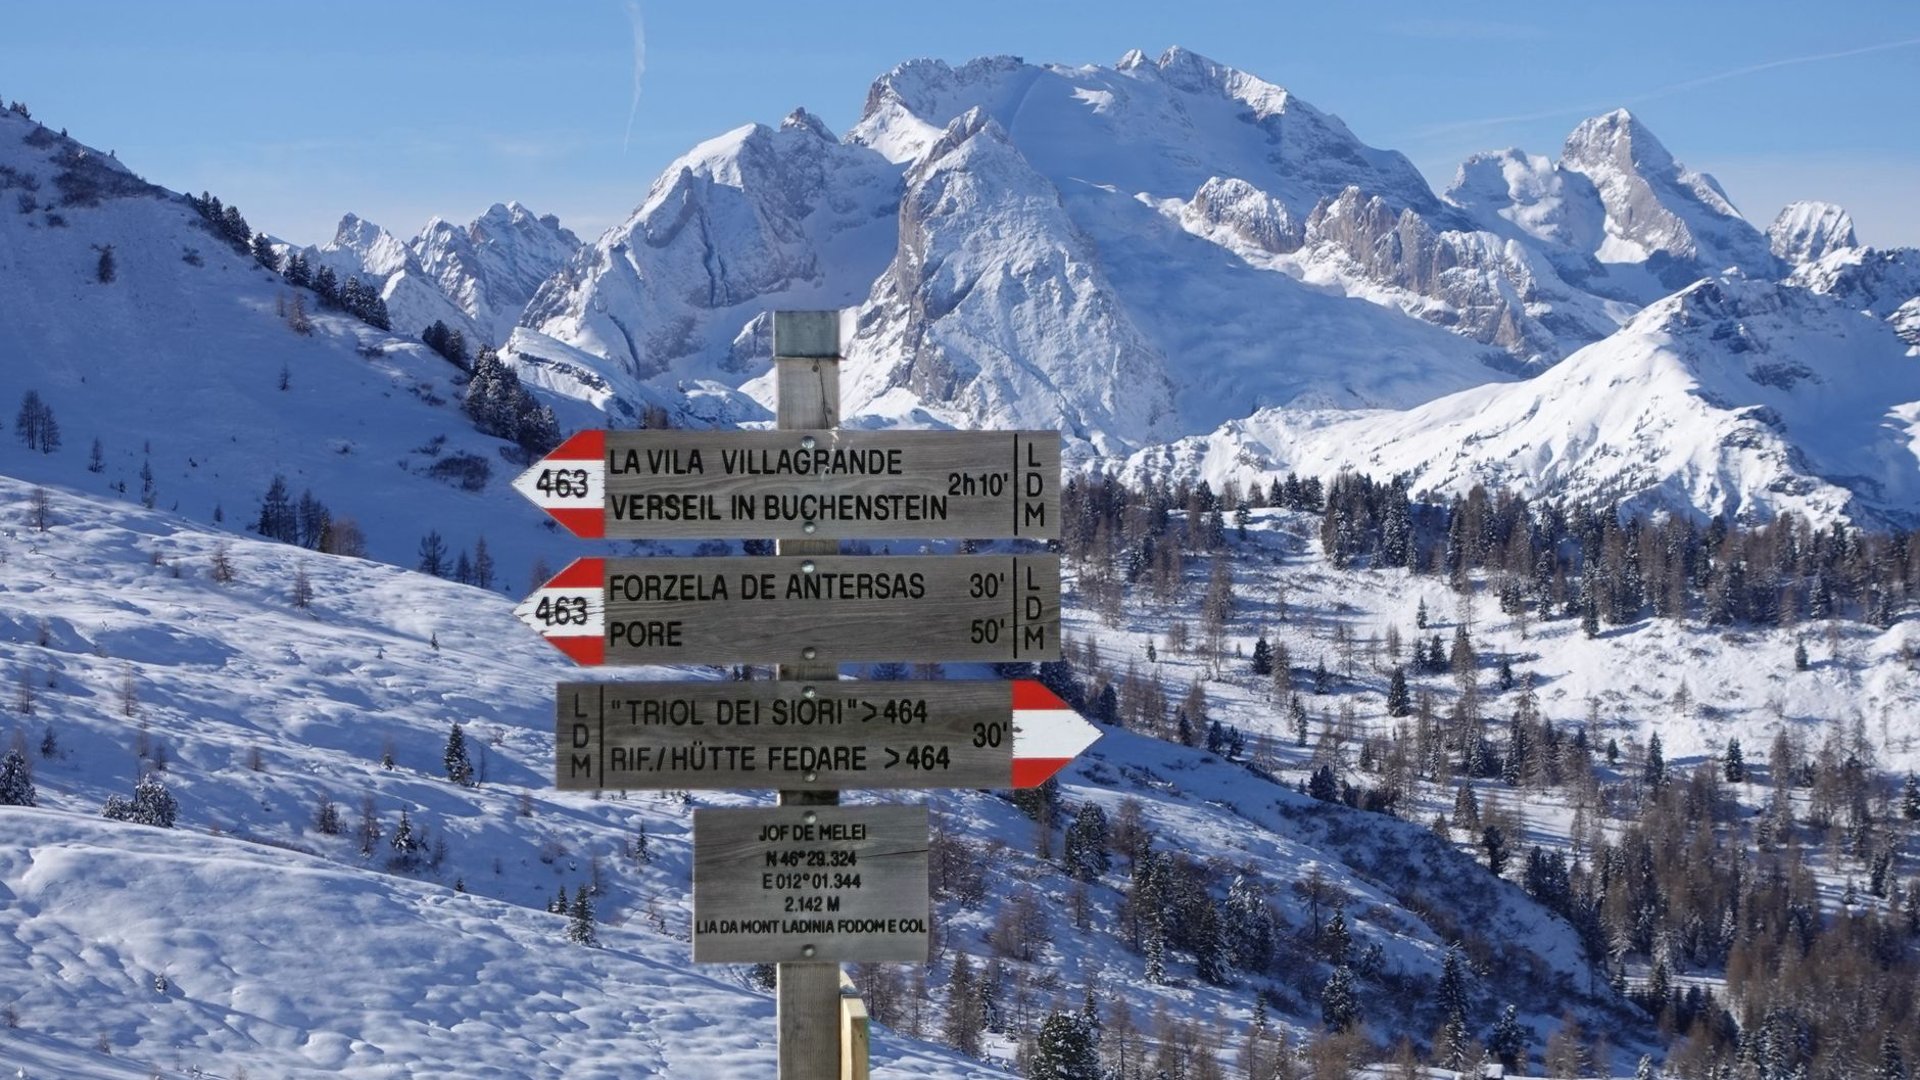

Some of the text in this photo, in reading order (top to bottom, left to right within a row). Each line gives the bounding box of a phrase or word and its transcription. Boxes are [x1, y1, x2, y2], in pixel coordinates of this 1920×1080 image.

[610, 449, 902, 475] LA VILA VILLAGRANDE
[536, 469, 588, 498] 463
[611, 493, 947, 521] VERSEIL IN BUCHENSTEIN
[610, 573, 925, 601] FORZELA DE ANTERSAS
[535, 595, 588, 626] 463
[610, 622, 682, 647] PORE
[717, 699, 759, 725] DEI
[768, 747, 867, 771] FEDARE
[758, 824, 866, 841] JOF DE MELEI
[785, 896, 840, 912] 2.142 M
[696, 919, 926, 934] LIA DA MONT LADINIA FODOM E COL
